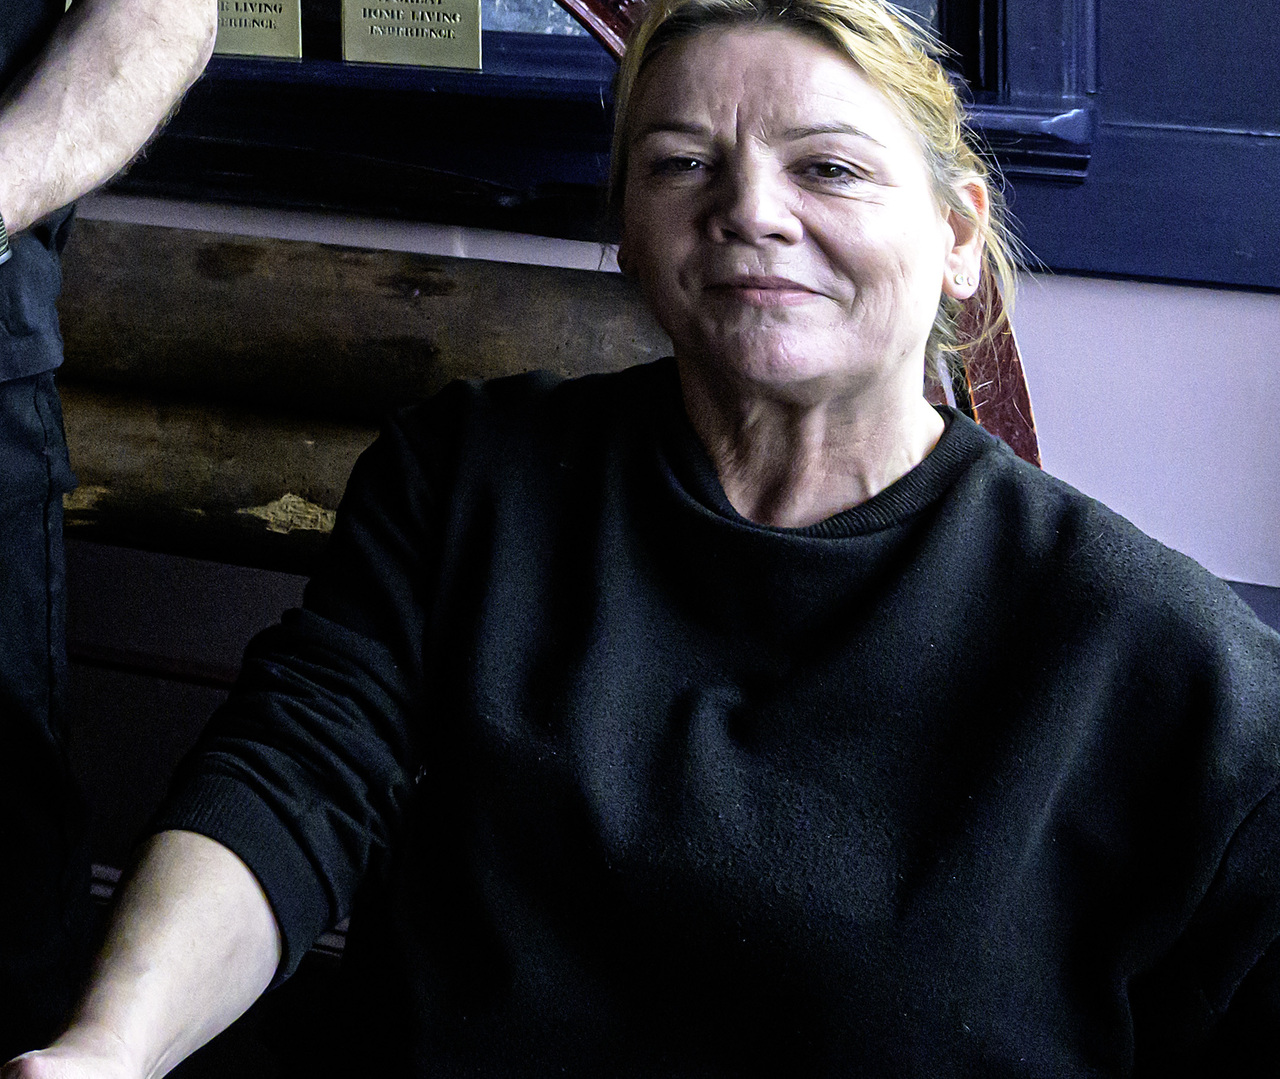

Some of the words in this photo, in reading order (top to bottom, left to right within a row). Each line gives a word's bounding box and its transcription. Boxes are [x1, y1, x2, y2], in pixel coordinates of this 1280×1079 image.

[235, 2, 283, 14] LIVING
[361, 7, 405, 20] HOME
[410, 10, 462, 24] LIVING
[368, 25, 457, 39] EXPERIENCE
